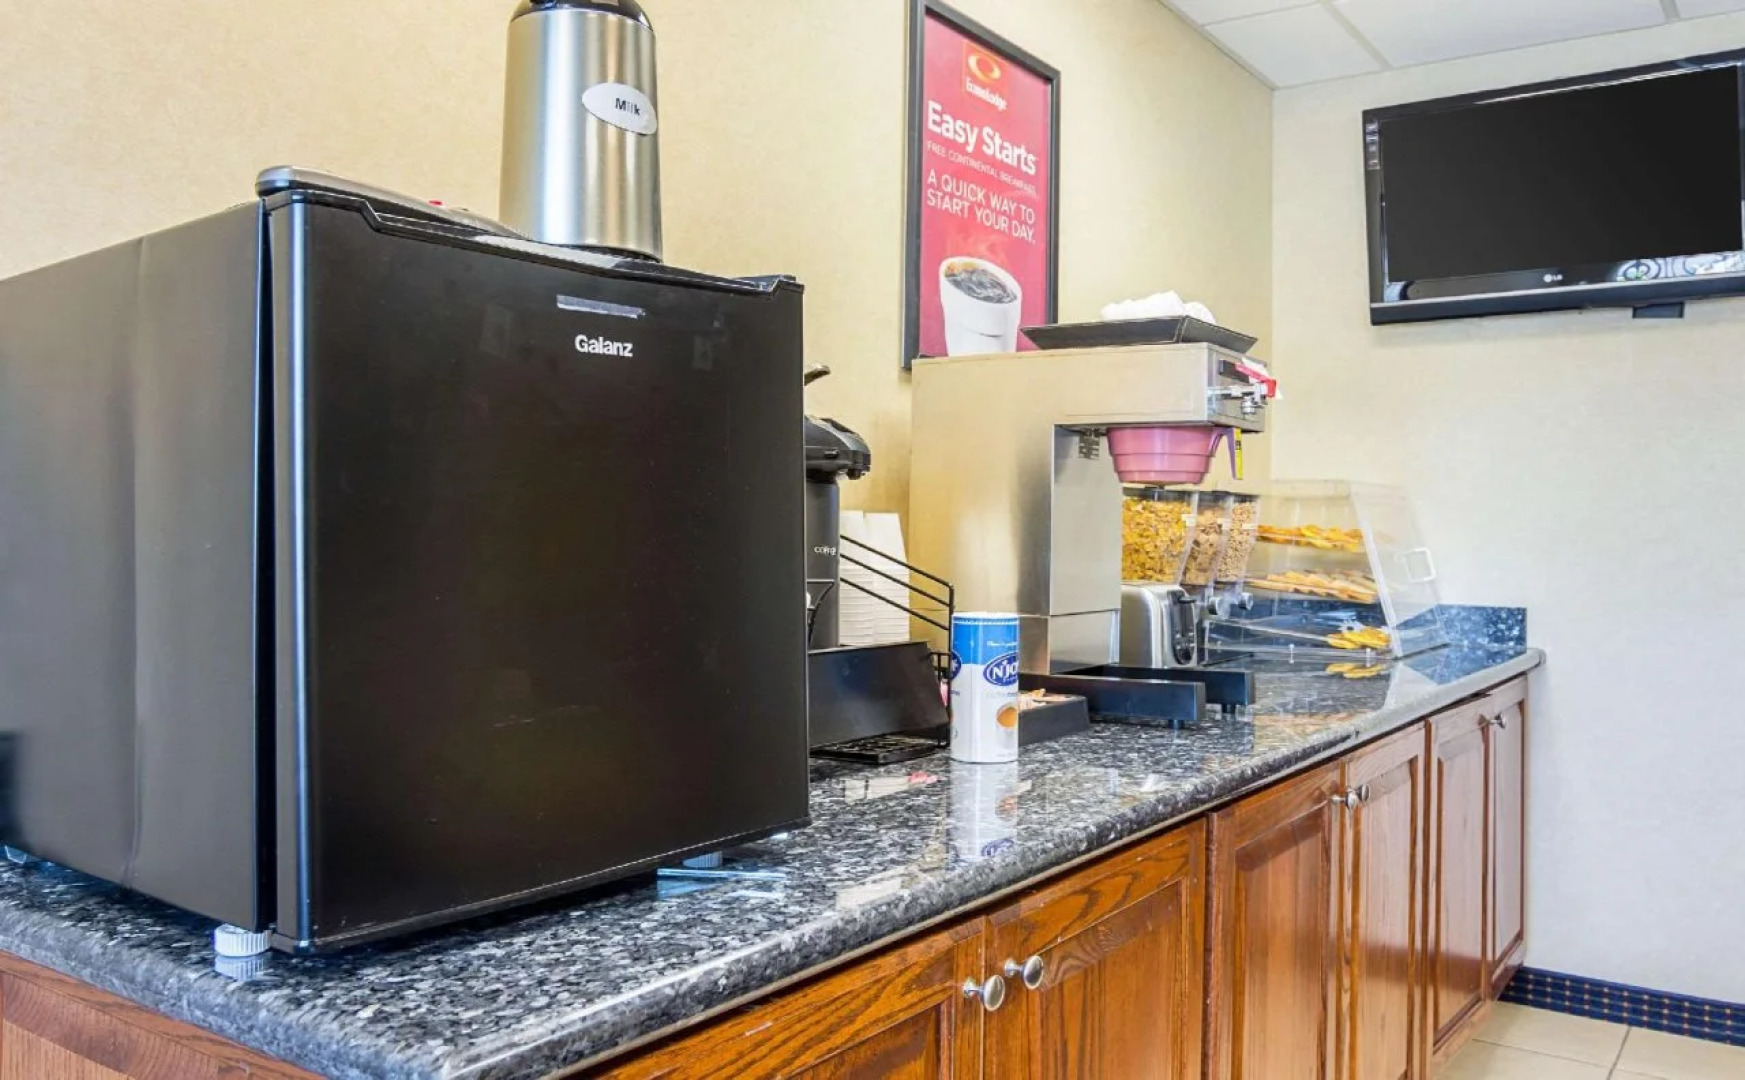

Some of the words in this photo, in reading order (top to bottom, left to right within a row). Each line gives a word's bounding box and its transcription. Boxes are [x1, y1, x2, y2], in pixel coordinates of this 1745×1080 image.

[615, 97, 640, 115] Milk
[927, 141, 946, 157] FREE
[928, 100, 978, 153] Easy
[982, 126, 1036, 175] Starts
[927, 168, 937, 187] A
[941, 174, 985, 206] QUICK
[989, 191, 1017, 216] WAY
[1019, 204, 1035, 225] TO
[927, 188, 970, 218] START
[974, 204, 1009, 233] YOUR
[1012, 220, 1036, 244] DAY.
[574, 334, 634, 357] Galanz
